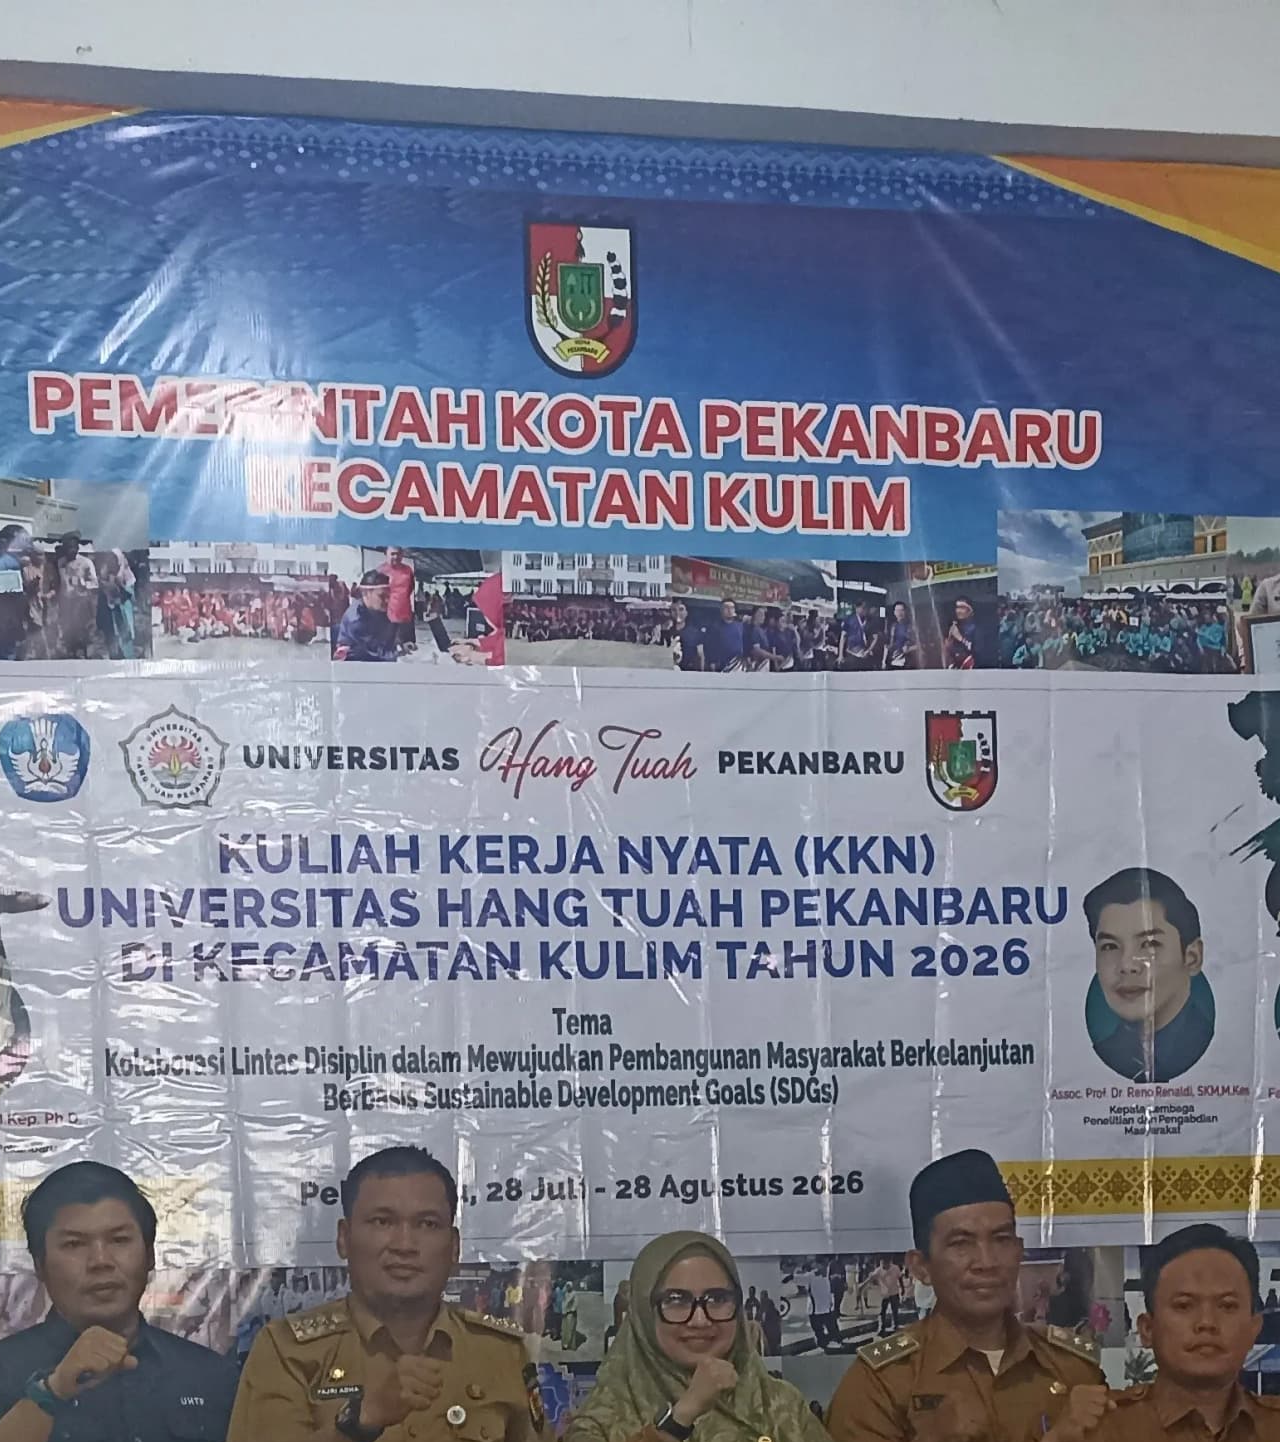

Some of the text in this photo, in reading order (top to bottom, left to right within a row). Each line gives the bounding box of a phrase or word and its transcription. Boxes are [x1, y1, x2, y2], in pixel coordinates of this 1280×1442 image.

[499, 394, 688, 454] KOTA
[704, 402, 1099, 467] PEKANBARU
[707, 476, 907, 533] KULIM
[242, 718, 906, 800] UNIVERSITAS Hang Tuah PEKANBARU
[219, 833, 936, 878] KULIAH KERJA NYATA (KKN)
[57, 886, 1069, 929] UNIVERSITAS HANG TUAH PEKANBARU
[120, 938, 1031, 983] DI KECAMATAN KULIM TAHUN 2026
[551, 1007, 613, 1037] Tema
[104, 1037, 1035, 1081] Kolaborasi Lintas Disiplin dalam Mewujudkan Pembangunan Masyarakat Berkelanjutan
[323, 1075, 839, 1115] Berbasis Sustainable Development Goals (SDGs)
[1127, 1086, 1154, 1099] Reno
[1083, 1115, 1135, 1126] Penelitian
[1158, 1113, 1218, 1125] Pengabdian
[485, 1182, 523, 1202] 28
[530, 1174, 586, 1203] Juli
[615, 1176, 651, 1200] 28
[660, 1172, 785, 1206] Agustus
[792, 1169, 865, 1196] 2026
